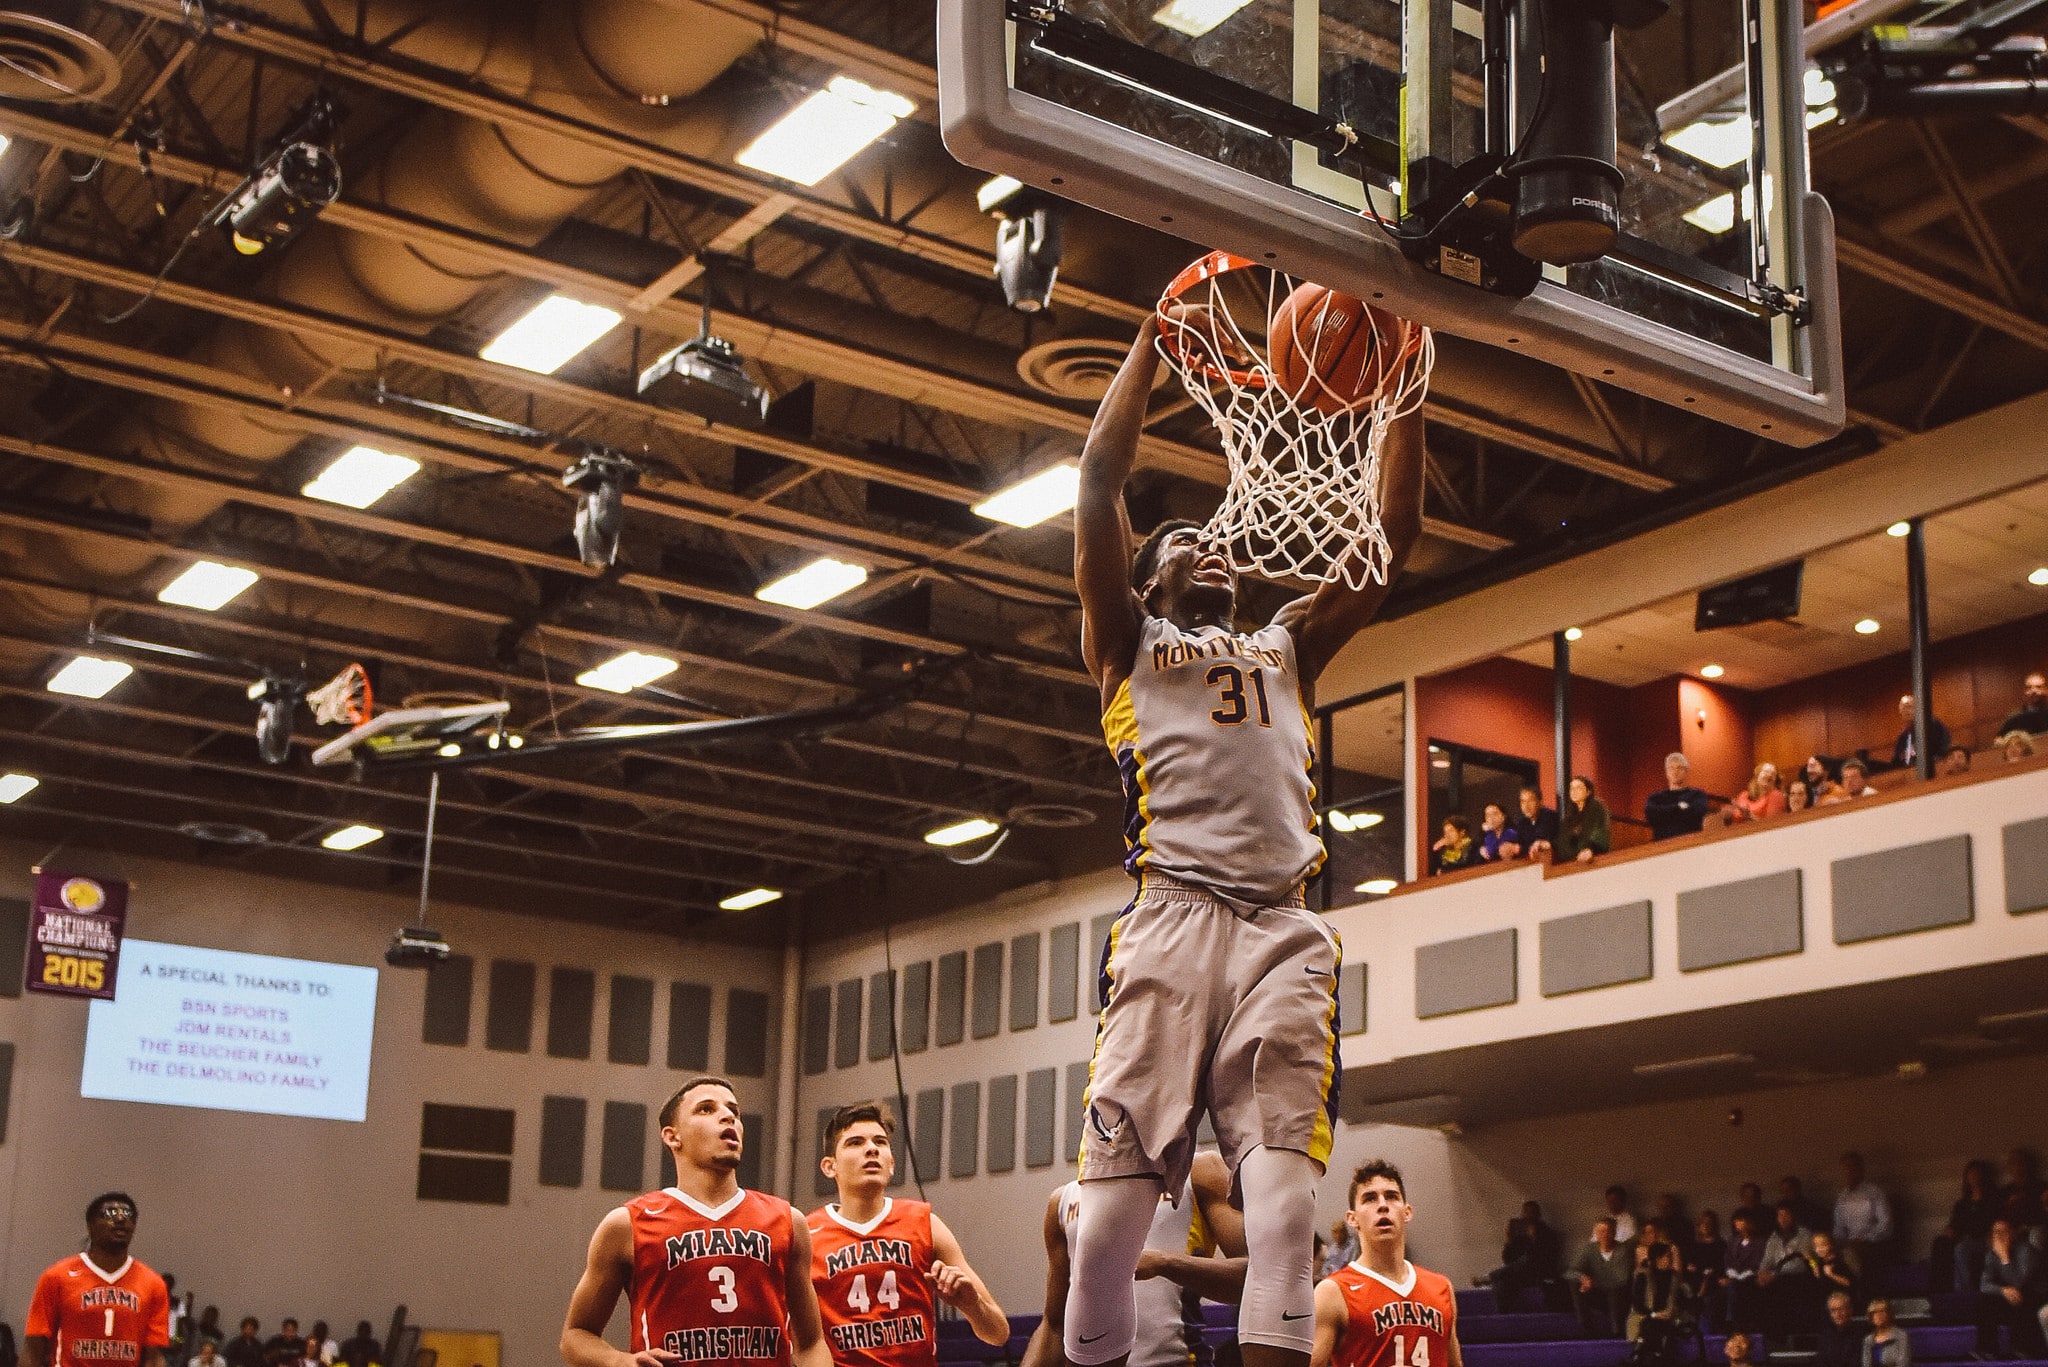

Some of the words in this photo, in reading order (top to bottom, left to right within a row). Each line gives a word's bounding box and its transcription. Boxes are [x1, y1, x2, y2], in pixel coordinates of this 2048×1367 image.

[1204, 663, 1272, 728] 31
[45, 913, 111, 935] NATIONAL
[43, 954, 105, 991] 2015
[141, 964, 153, 976] A
[157, 966, 227, 985] SPECIAL
[234, 974, 302, 994] THANKS
[182, 999, 217, 1015] BSN
[222, 1004, 289, 1023] SPORTS
[215, 1025, 291, 1045] RENTALS
[139, 1038, 173, 1054] THE
[265, 1051, 321, 1069] FAMILY
[127, 1059, 160, 1075] THE
[165, 1062, 267, 1086] DELMOLINO
[272, 1074, 329, 1091] FAMILY
[665, 1228, 772, 1271] MIAMI
[825, 1239, 914, 1280] MIAMI
[81, 1286, 140, 1313] MIAMI
[708, 1266, 738, 1313] 3
[847, 1270, 900, 1313] 44
[104, 1307, 115, 1337] 1
[830, 1314, 927, 1351] CHRISTIAN
[1371, 1301, 1444, 1337] MIAMI
[72, 1338, 137, 1361] CHRISTIAN
[663, 1325, 781, 1363] CHRISTIAN
[1394, 1334, 1430, 1367] 14
